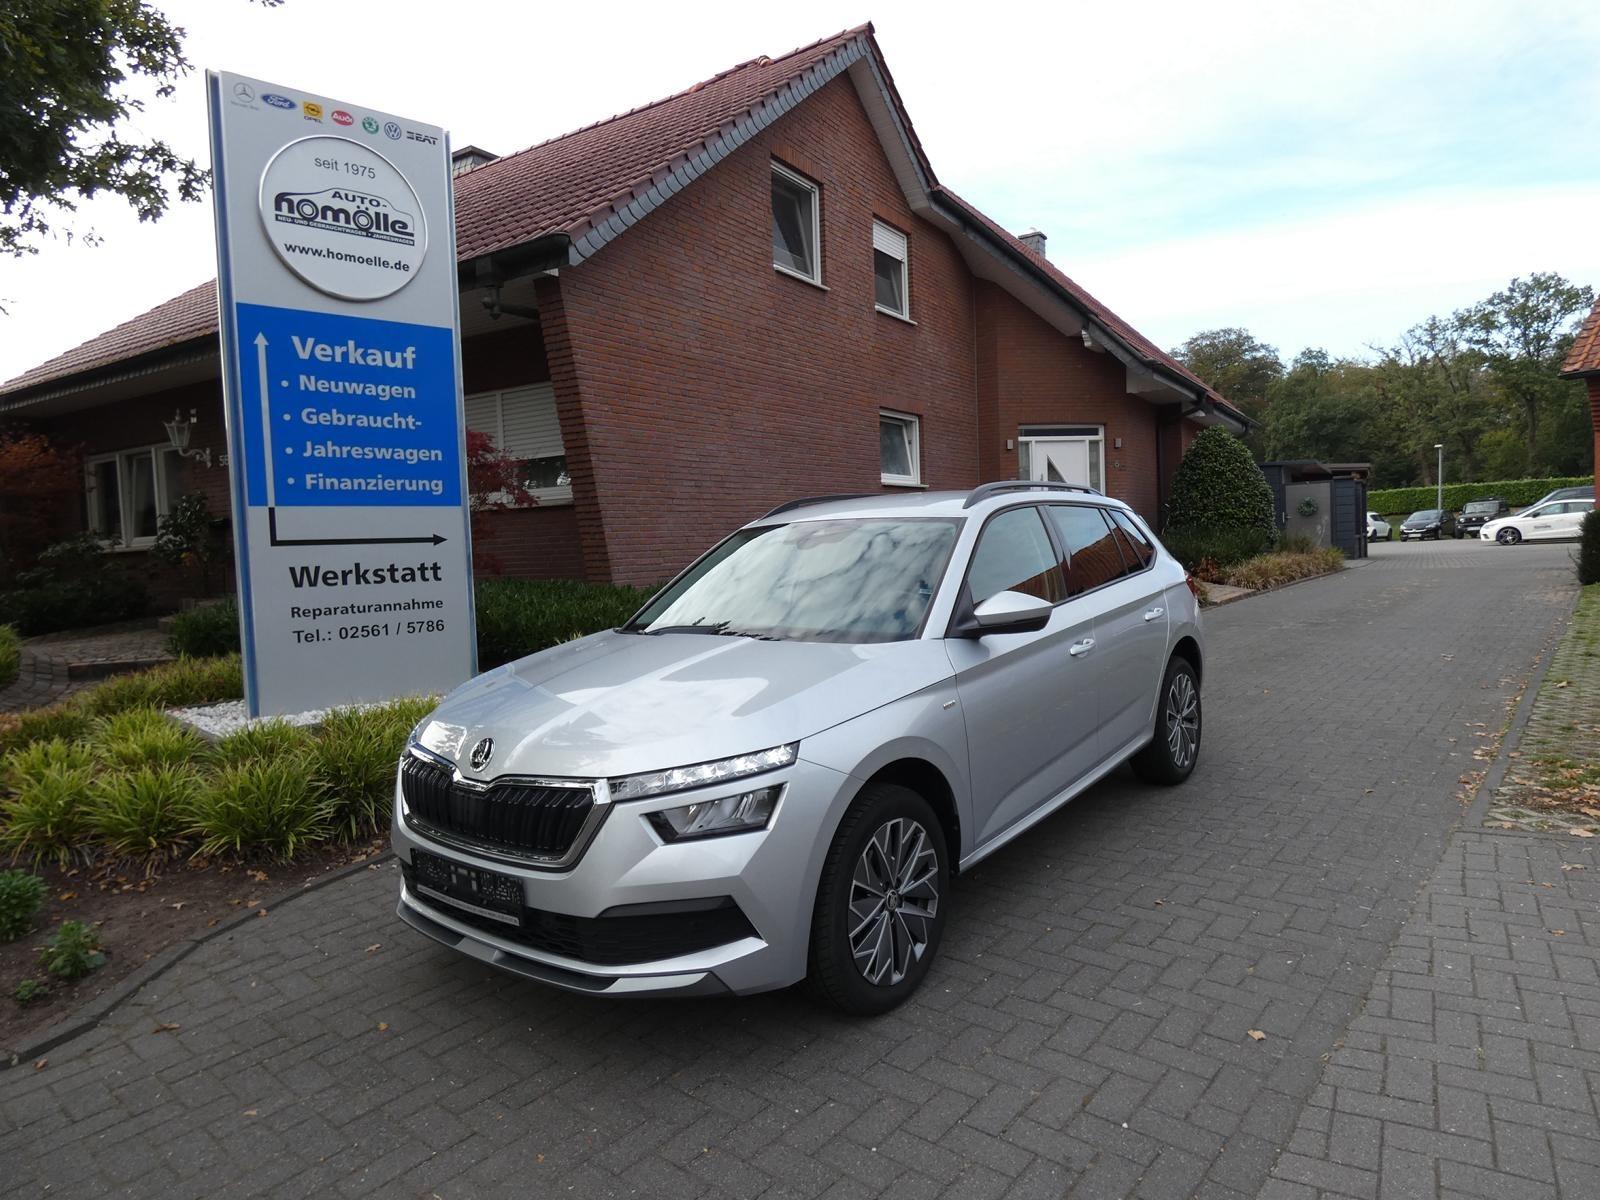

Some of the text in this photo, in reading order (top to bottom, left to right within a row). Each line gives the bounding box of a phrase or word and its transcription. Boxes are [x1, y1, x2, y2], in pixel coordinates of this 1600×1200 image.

[267, 95, 290, 108] Ford
[303, 115, 323, 124] OPEL
[406, 130, 439, 145] SEAT
[314, 156, 376, 180] seit 1975
[331, 191, 387, 208] AUTO-
[274, 192, 415, 238] homölle
[284, 243, 410, 272] www.homoelle.de
[291, 335, 416, 370] Verkauf
[299, 375, 416, 400] Neuwagen
[301, 408, 422, 430] Gebraucht-
[303, 440, 443, 465] Jahreswagen
[305, 473, 444, 495] Finanzierung
[289, 561, 443, 588] Werkstatt
[290, 598, 444, 619] Reparaturannahme
[292, 630, 332, 644] Tel.:
[338, 623, 389, 640] 02561
[406, 619, 445, 634] 5786
